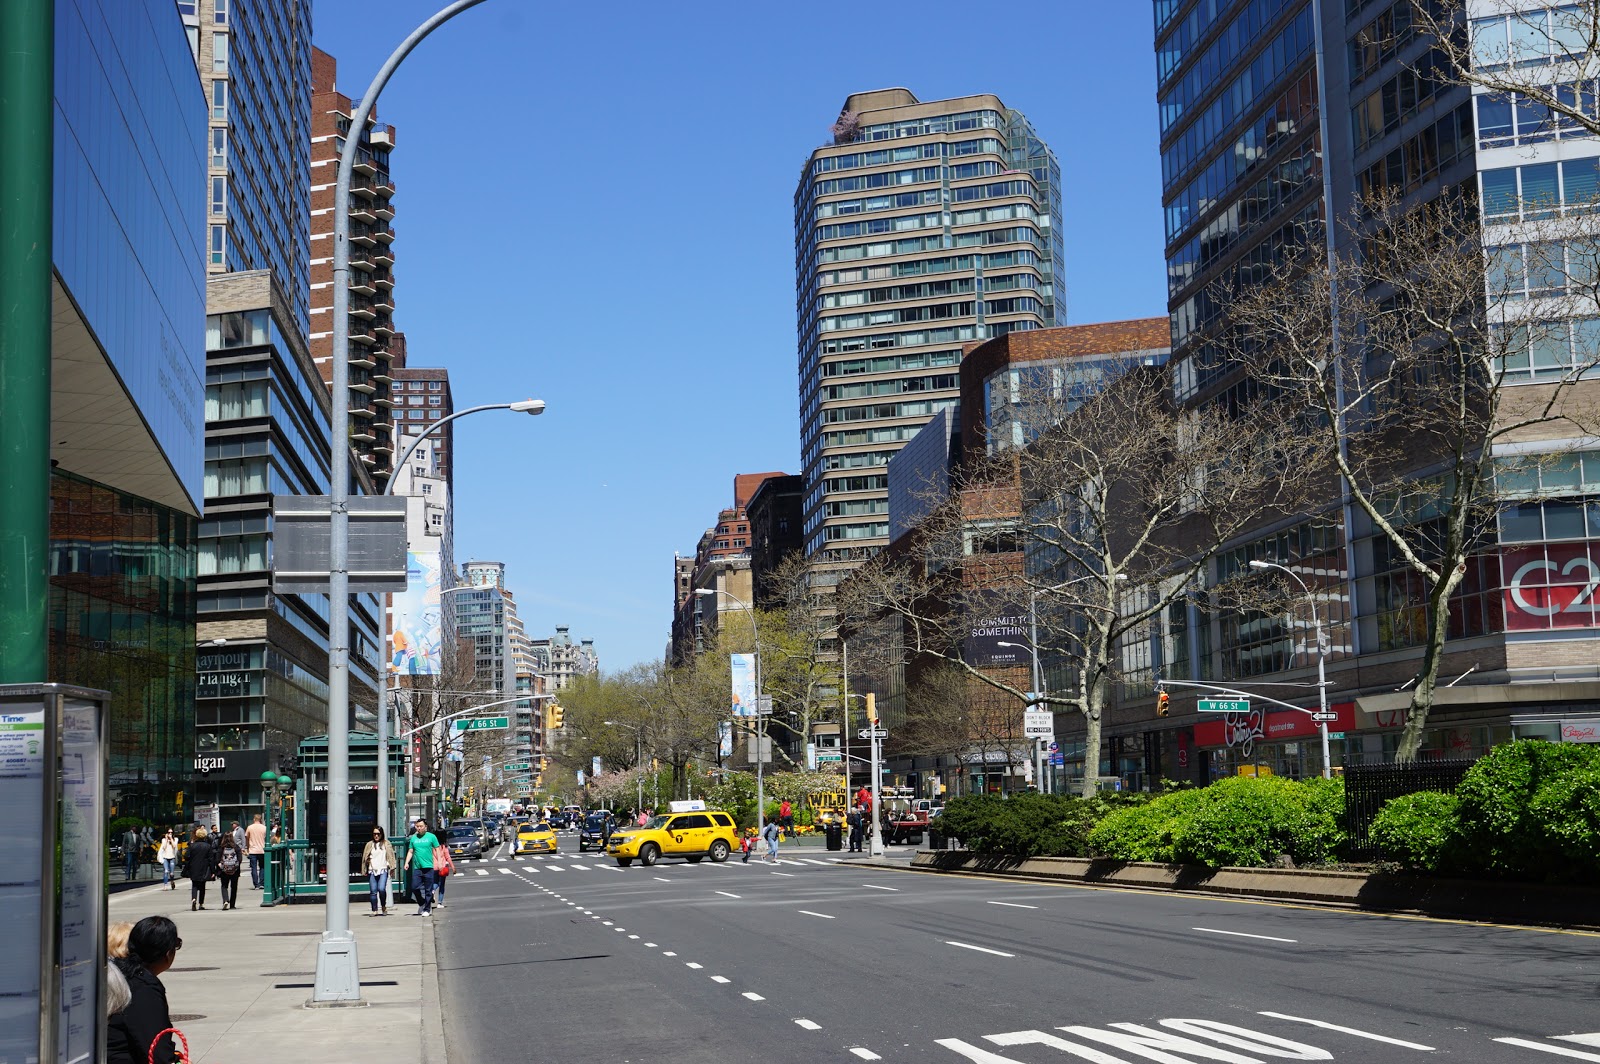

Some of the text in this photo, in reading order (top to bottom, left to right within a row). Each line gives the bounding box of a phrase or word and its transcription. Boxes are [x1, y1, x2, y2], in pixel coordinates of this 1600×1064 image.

[971, 627, 1028, 637] SOMETHIN
[1209, 702, 1239, 710] W 66 St
[2, 715, 24, 723] Time
[477, 720, 487, 728] 66
[489, 719, 498, 727] St
[808, 794, 846, 806] WILD
